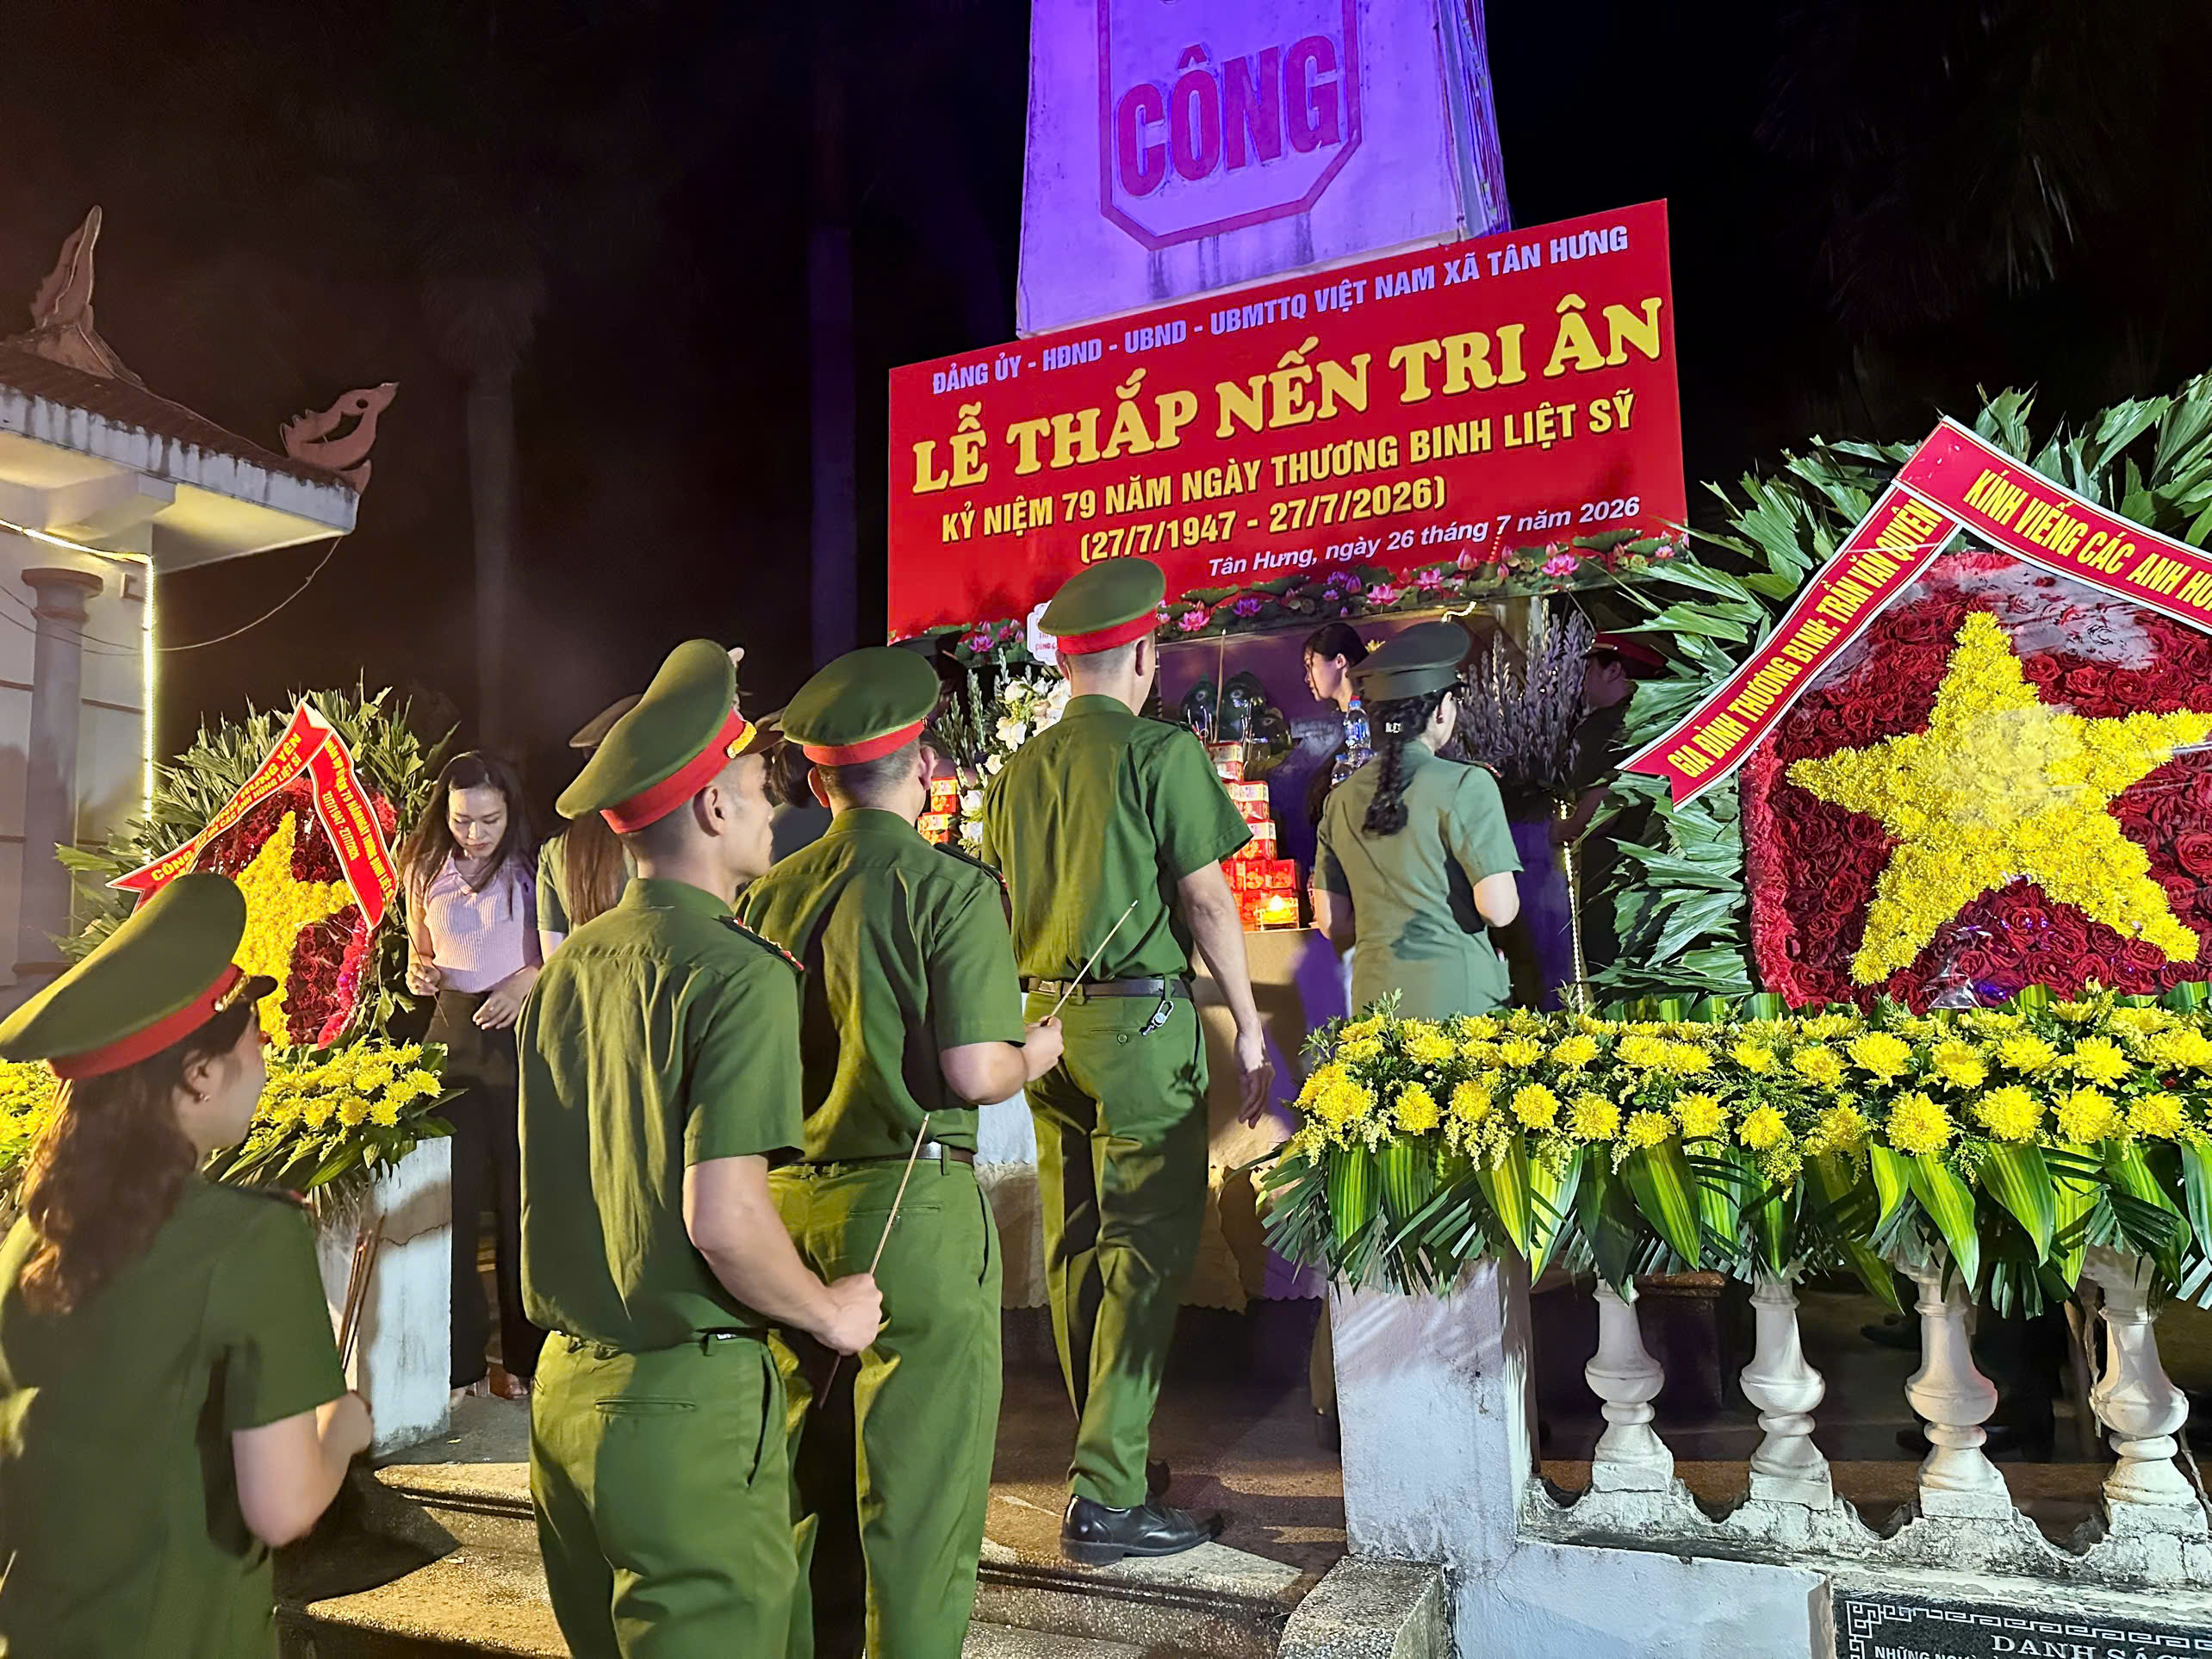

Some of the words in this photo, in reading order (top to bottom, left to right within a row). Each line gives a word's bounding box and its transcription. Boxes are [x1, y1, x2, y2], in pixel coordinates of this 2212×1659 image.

[1115, 35, 1340, 197] CÔNG
[933, 362, 988, 395] ĐẢNG
[995, 352, 1022, 382] ỦY
[1042, 339, 1102, 371] HĐND
[1125, 320, 1186, 353] UBND
[1211, 296, 1307, 335] UBMTTQ
[1314, 279, 1366, 314] VIỆT
[1375, 266, 1435, 301] NAM
[1444, 254, 1480, 284] XÃ
[1488, 244, 1541, 276] TÂN
[1550, 226, 1628, 263] HƯNG
[912, 401, 988, 494] LỄ
[1006, 368, 1198, 475] THẮP
[1215, 336, 1370, 438] NẾN
[1389, 324, 1526, 402] TRI
[1543, 294, 1662, 376] ÂN
[941, 501, 975, 543] KỶ
[984, 496, 1053, 537] NIỆM
[1063, 489, 1096, 521] 79
[1105, 475, 1171, 514] NĂM
[1182, 458, 1261, 500] NGÀY
[1271, 435, 1398, 487] THƯƠNG
[1410, 418, 1491, 463] BINH
[1504, 402, 1575, 451] LIỆT
[1588, 388, 1634, 432] SỸ
[1081, 510, 1236, 564] (27/7/1947
[1270, 475, 1445, 533] 27/7/2026)
[1209, 556, 1247, 577] Tân
[1253, 547, 1318, 570] Hưng,
[1326, 536, 1381, 562] ngày
[1388, 530, 1414, 551] 26
[1421, 519, 1488, 546] tháng
[1495, 515, 1508, 532] 7
[1517, 508, 1571, 532] năm
[1580, 496, 1640, 523] 2026
[1962, 468, 2029, 526] KÍNH
[2013, 500, 2089, 557] VIẾNG
[2077, 531, 2136, 575] CÁC
[2125, 552, 2192, 595] ANH
[1668, 744, 1715, 778] GIA
[1692, 712, 1750, 760] ĐÌNH
[1727, 656, 1803, 723] THƯƠNG
[1815, 580, 1874, 624] TRẦN
[1847, 549, 1901, 589] VĂN
[276, 732, 301, 762] YÊN
[340, 789, 354, 803] 79
[1991, 1635, 2097, 1659] DANH
